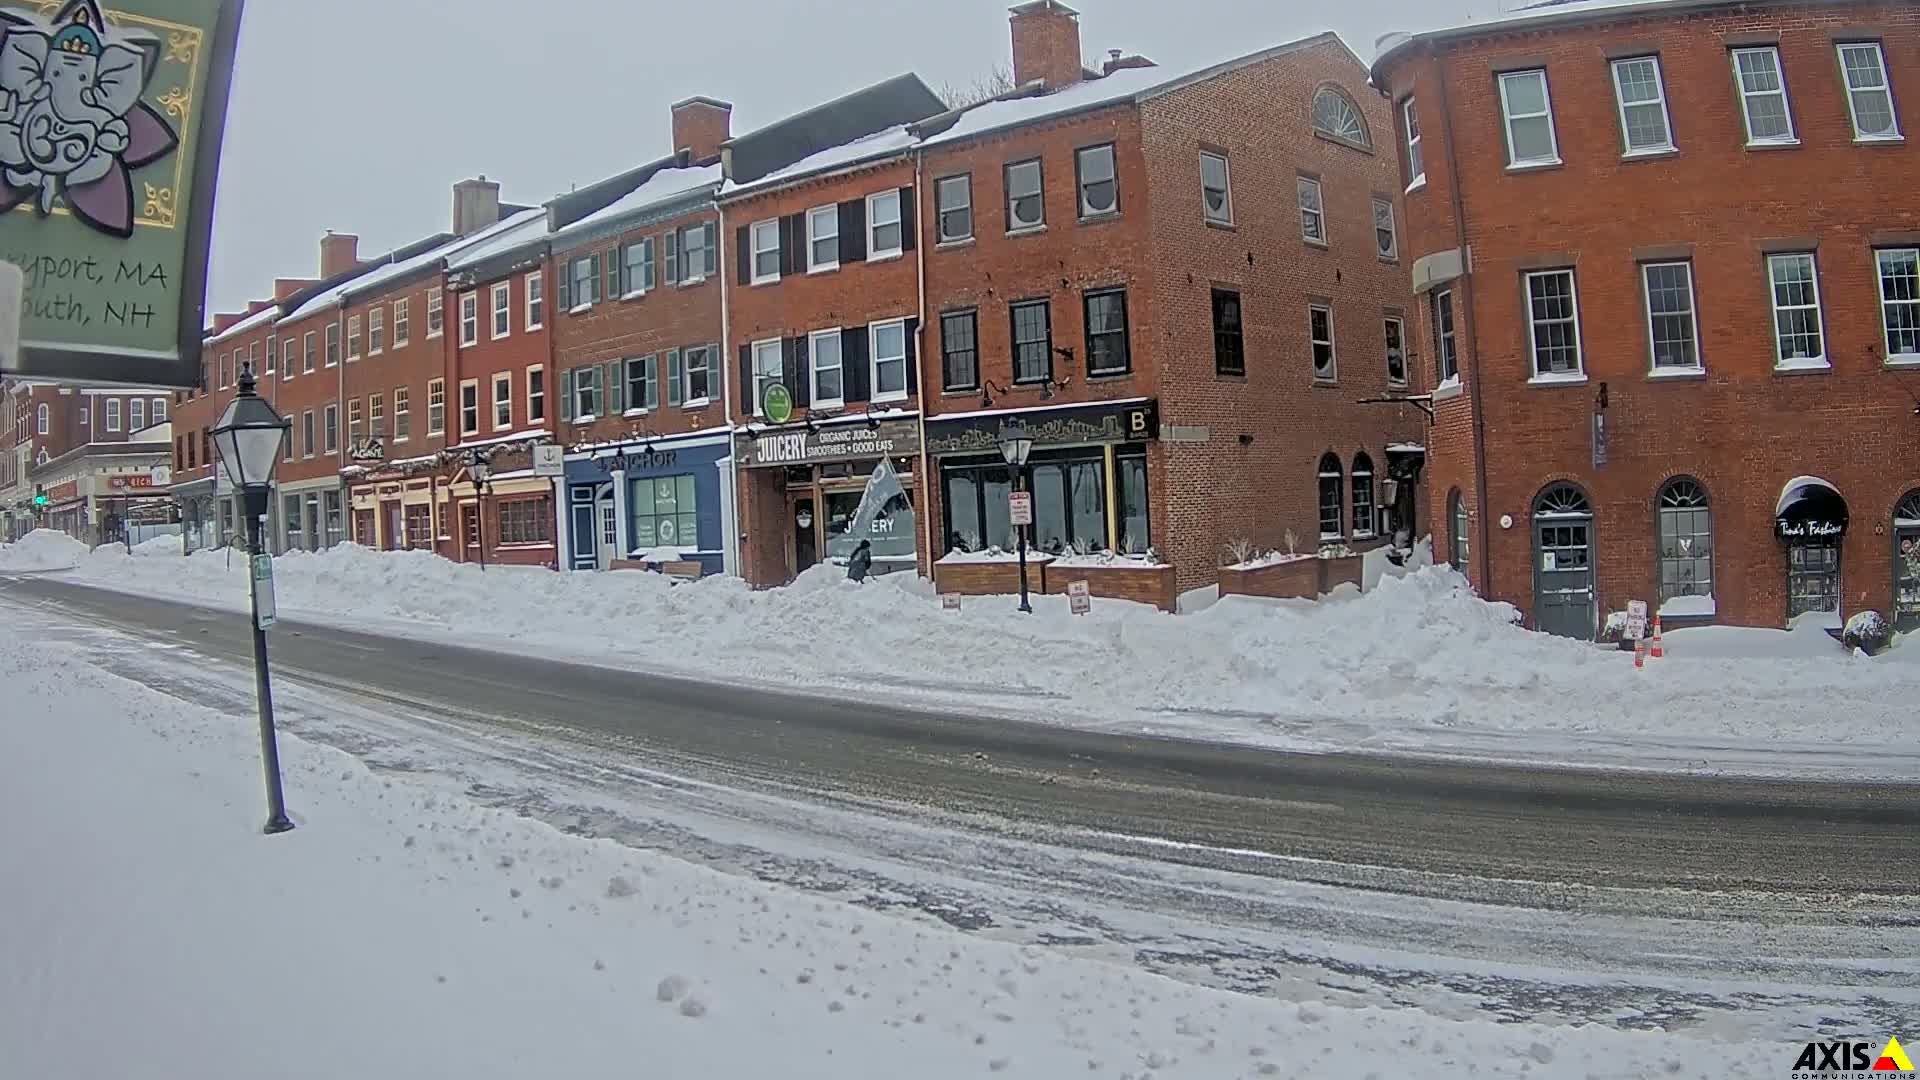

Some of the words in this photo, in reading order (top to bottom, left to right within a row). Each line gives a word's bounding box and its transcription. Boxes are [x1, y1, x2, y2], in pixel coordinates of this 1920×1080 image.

[8, 253, 104, 288] yport,
[114, 260, 168, 289] MA
[103, 301, 156, 328] NH
[756, 433, 807, 463] JUICERY
[819, 431, 850, 444] ORGANIC
[852, 429, 878, 441] JUICES
[806, 445, 847, 457] SMOOTHIES
[852, 442, 875, 453] GOOD
[875, 440, 894, 451] EATS
[609, 451, 677, 471] ANCHOR
